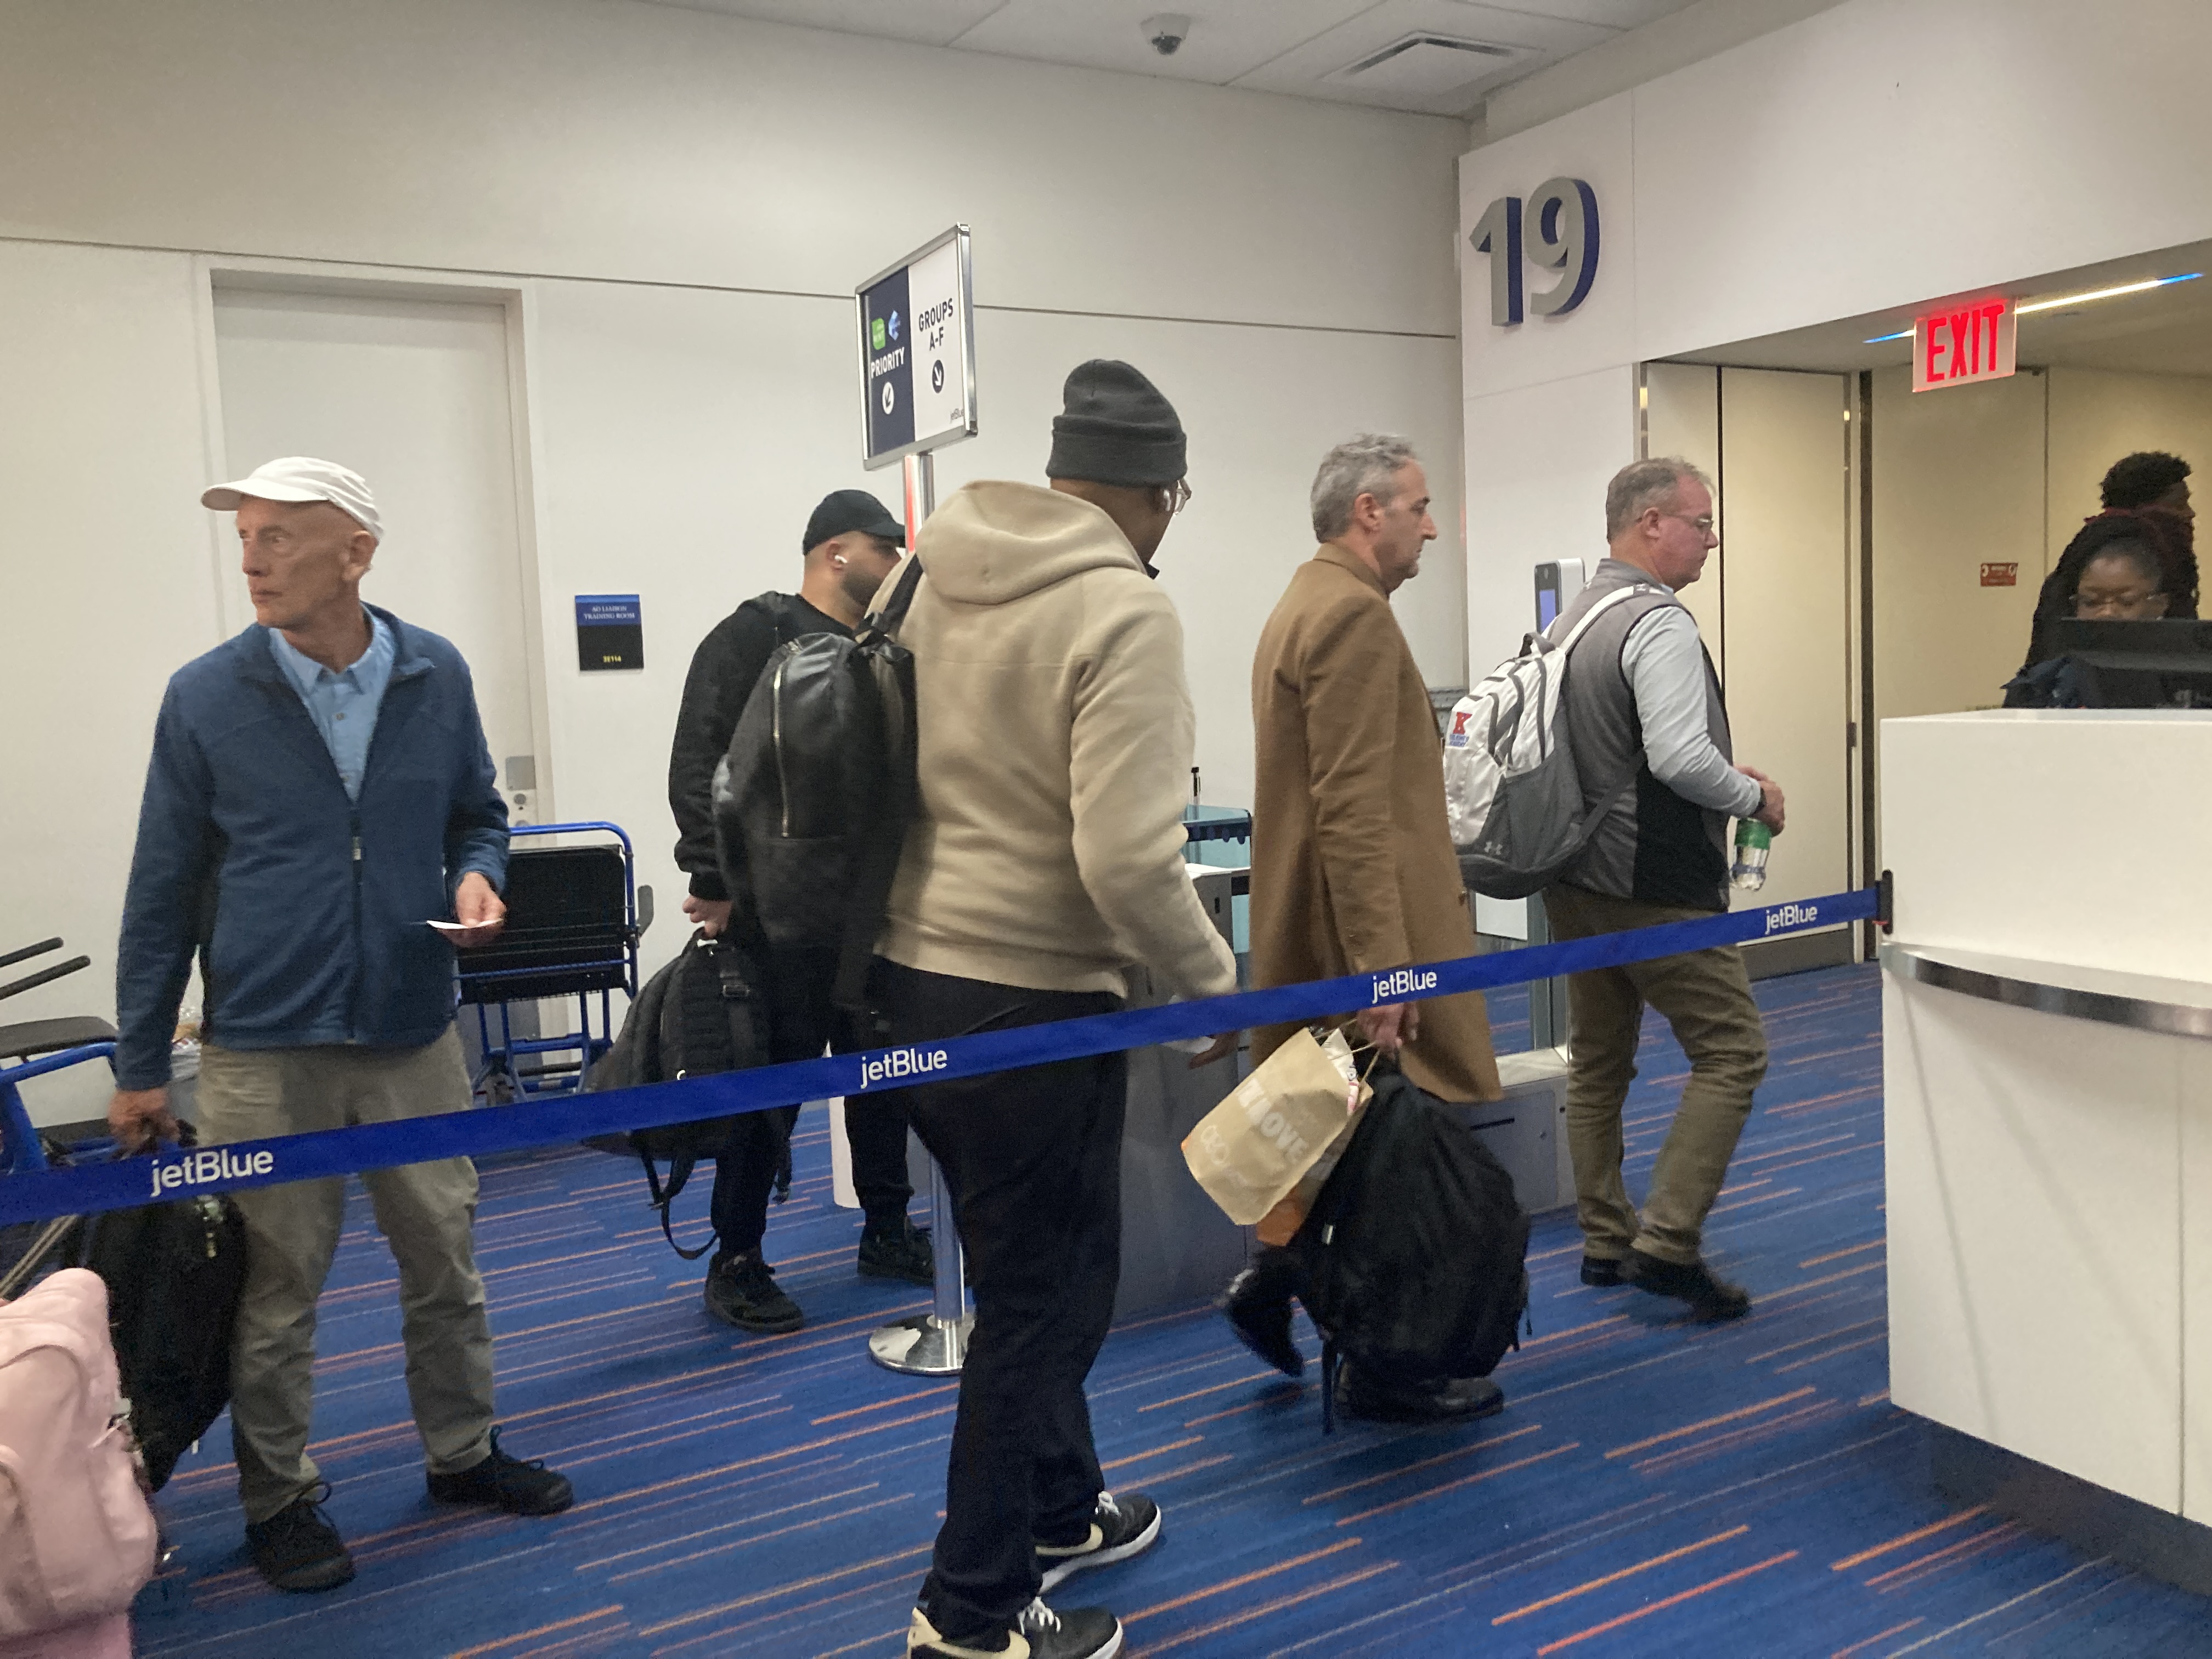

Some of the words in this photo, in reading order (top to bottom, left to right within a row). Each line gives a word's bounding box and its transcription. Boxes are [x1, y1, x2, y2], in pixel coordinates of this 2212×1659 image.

[1469, 176, 1599, 327] 19
[918, 298, 953, 332] GROUPS
[929, 326, 944, 351] A-F
[1927, 304, 2004, 383] EXIT
[871, 347, 905, 379] PRIORITY
[1765, 905, 1817, 935] jetBlue
[1372, 969, 1437, 1004] jetBlue
[860, 1048, 947, 1089] jetBlue
[150, 1149, 273, 1198] jetBlue
